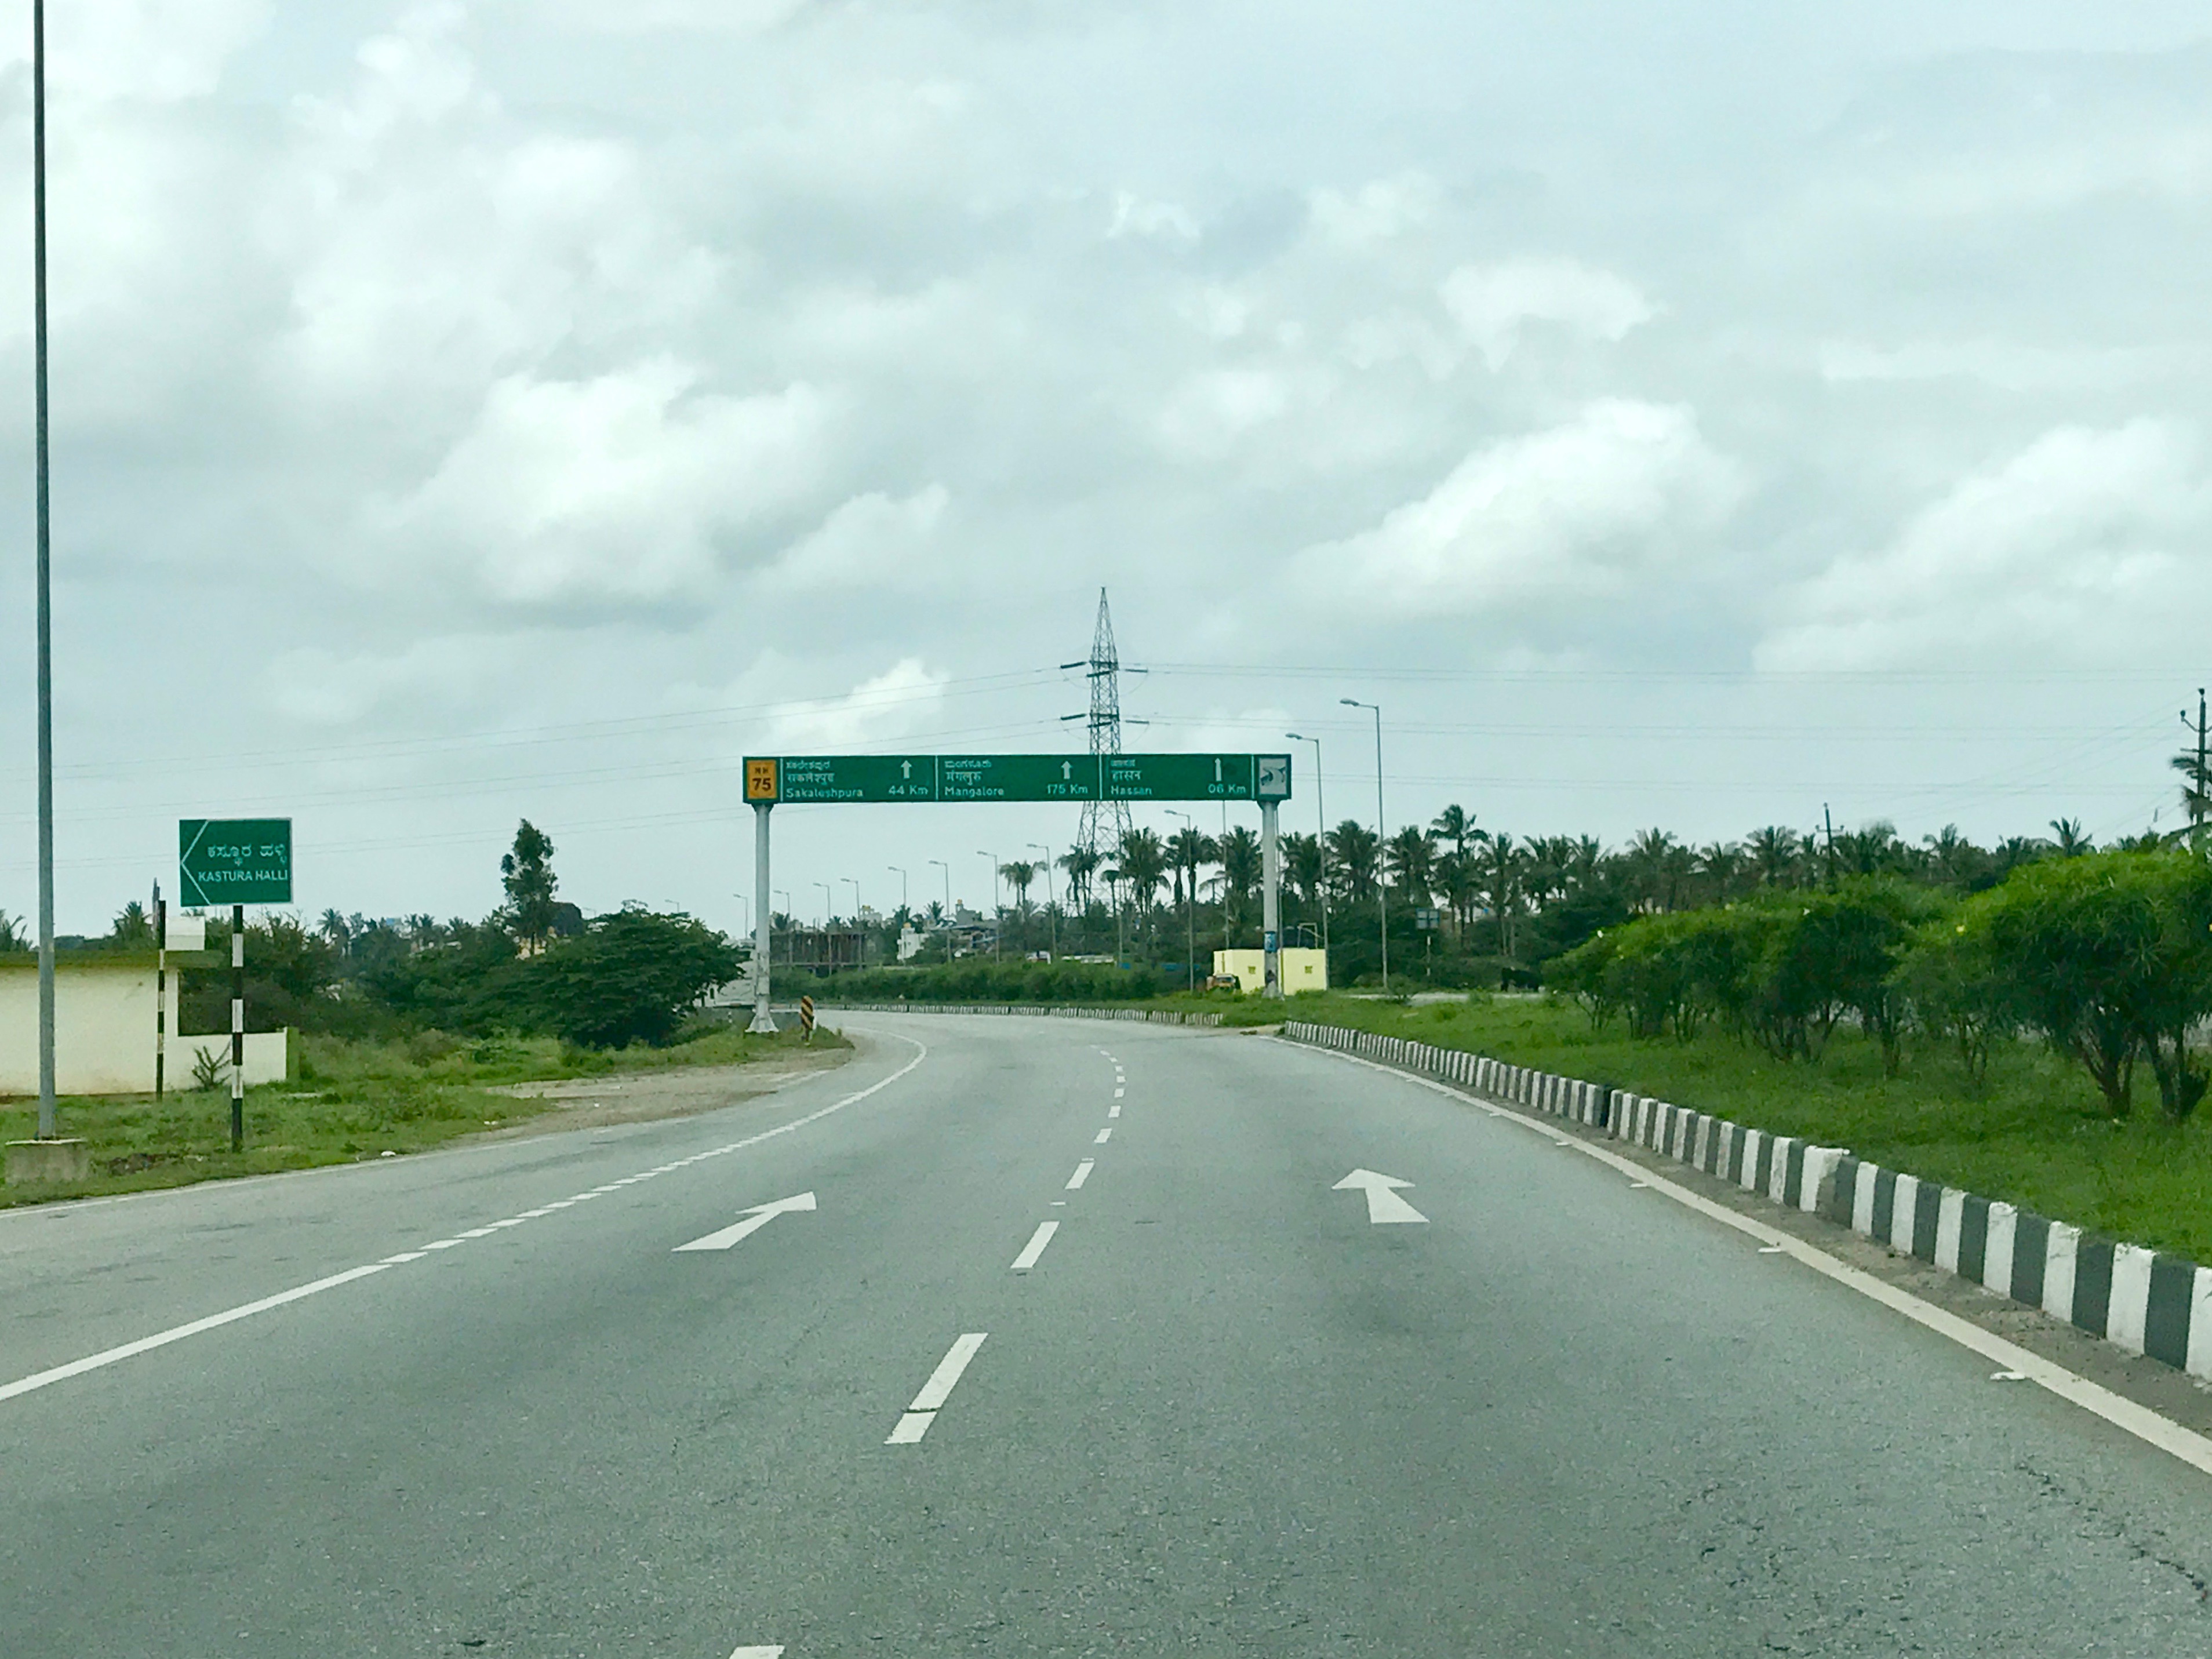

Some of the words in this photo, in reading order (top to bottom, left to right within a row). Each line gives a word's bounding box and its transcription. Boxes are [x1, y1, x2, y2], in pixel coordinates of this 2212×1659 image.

[753, 778, 772, 792] 75
[889, 785, 904, 795] 44
[909, 784, 928, 795] Km
[1047, 784, 1065, 795] 175
[1069, 784, 1088, 794] Km
[1111, 785, 1152, 795] Hassan
[1207, 784, 1224, 794] 06
[1228, 784, 1246, 794] Km
[786, 788, 863, 799] Sakaleshpura
[944, 786, 1004, 798] Mangalore
[198, 870, 253, 882] KASTURA
[255, 869, 288, 881] HALLI
